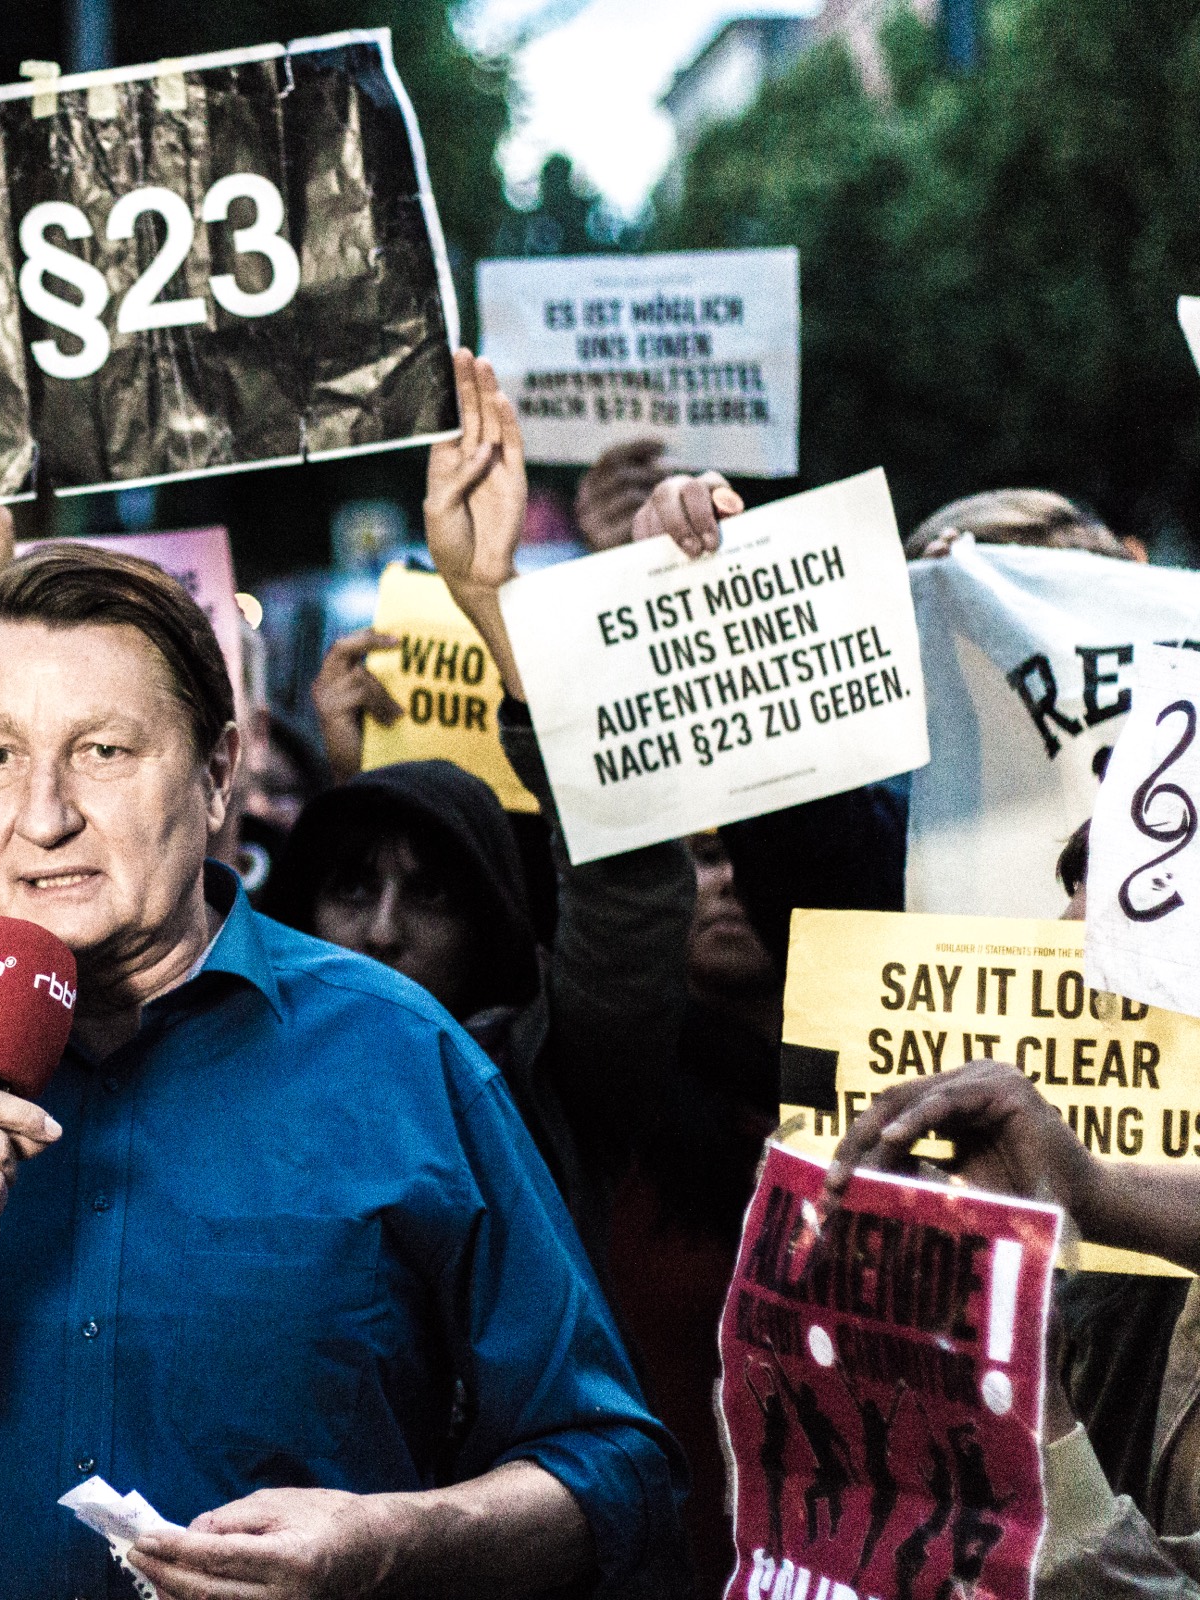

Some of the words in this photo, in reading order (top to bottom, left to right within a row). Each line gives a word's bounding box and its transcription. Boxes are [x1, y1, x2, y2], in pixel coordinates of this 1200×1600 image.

[19, 172, 301, 380] §23
[598, 605, 639, 647] ES
[645, 588, 693, 632] IST
[703, 545, 845, 616] MÖGLICH
[401, 634, 485, 686] WHO
[650, 630, 716, 676] UNS
[723, 600, 819, 656] EINEN
[410, 687, 487, 732] OUR
[597, 625, 892, 741] AUFENTHALTSTITEL
[593, 731, 682, 786] NACH
[691, 711, 753, 766] §23
[760, 698, 801, 739] ZU
[809, 666, 912, 725] GEBEN.
[985, 944, 1032, 957] STATEMENTS
[1033, 946, 1056, 958] FROM
[1058, 948, 1072, 958] THE
[34, 971, 75, 1009] rbb
[880, 961, 962, 1013] SAY
[976, 966, 1016, 1016] IT
[868, 1027, 948, 1076] SAY
[962, 1033, 1001, 1064] IT
[1015, 1035, 1160, 1090] CLEAR
